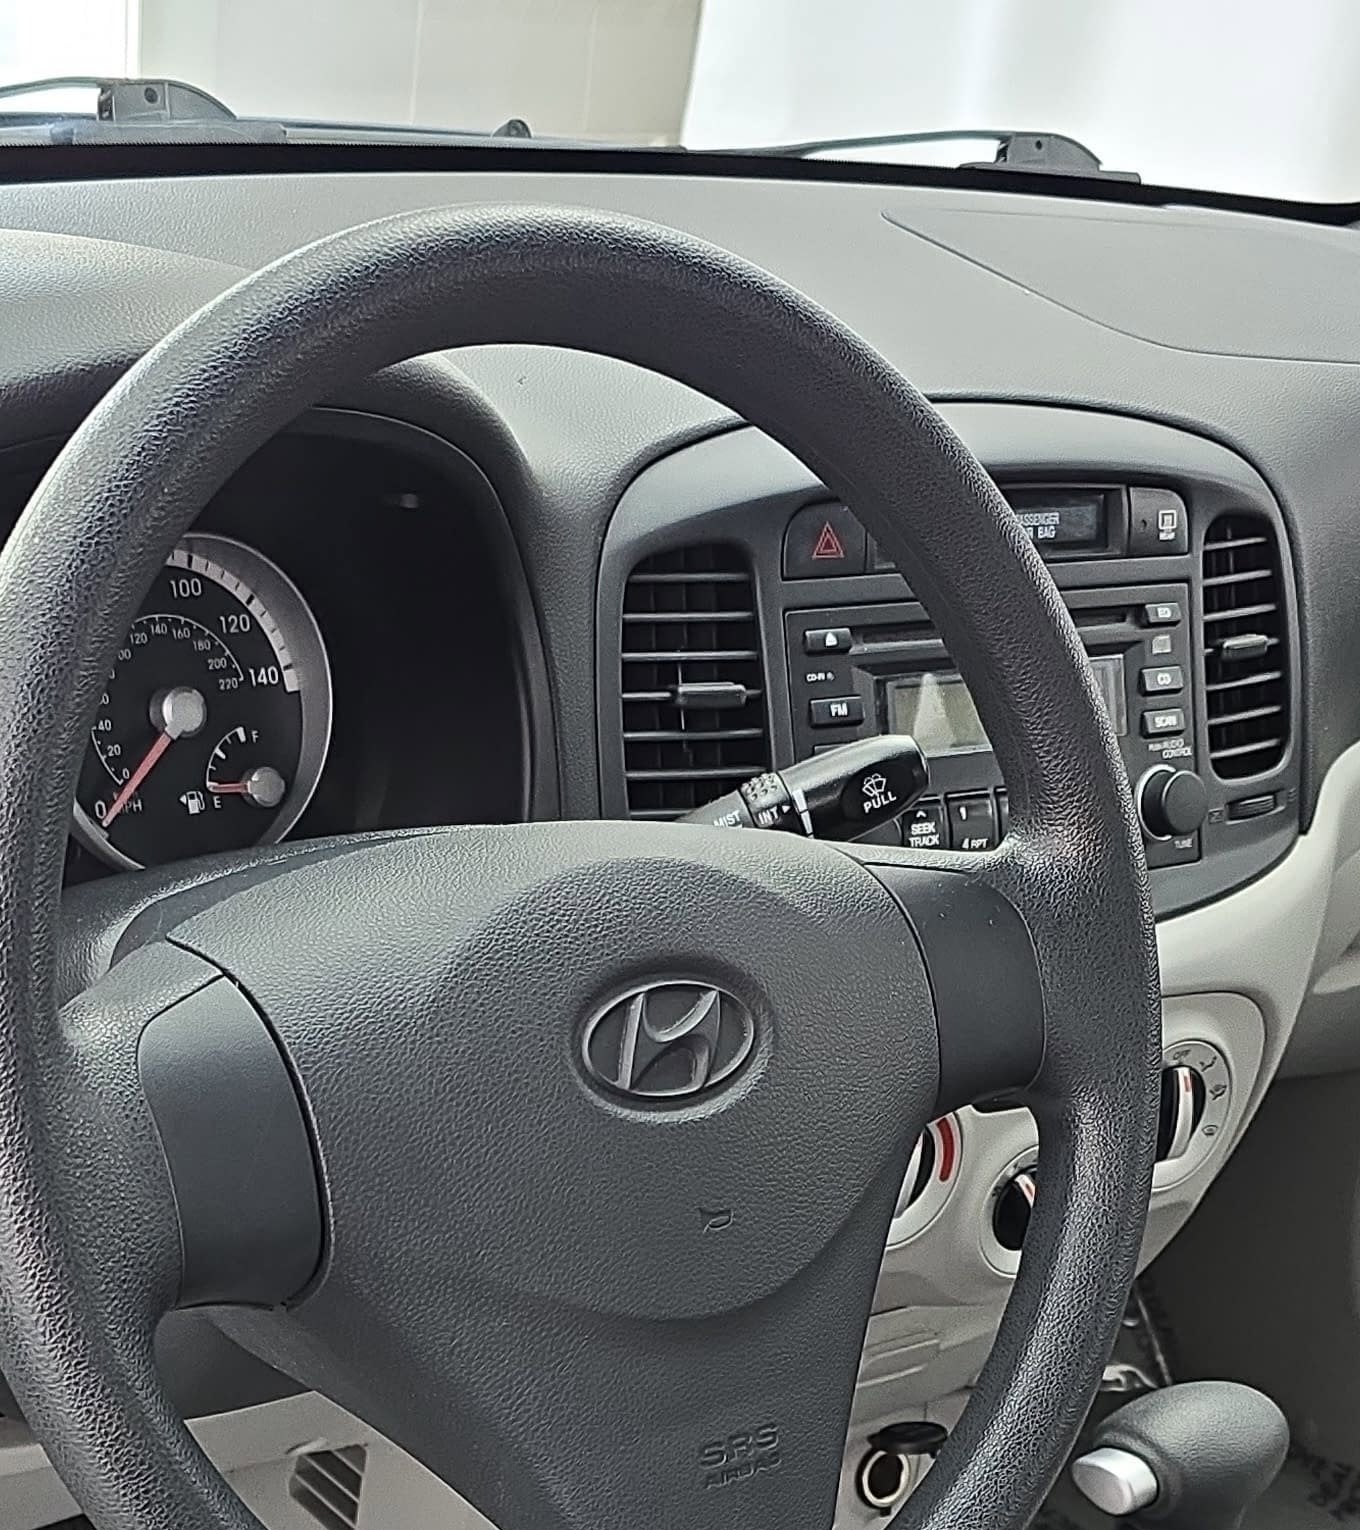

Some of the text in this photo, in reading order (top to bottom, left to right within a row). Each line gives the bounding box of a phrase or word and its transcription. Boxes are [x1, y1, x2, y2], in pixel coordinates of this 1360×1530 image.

[170, 578, 202, 598] 100
[150, 623, 168, 635] 140
[219, 614, 251, 634] 120
[130, 632, 148, 645] 120
[172, 628, 190, 640] 160
[207, 658, 227, 671] 200
[249, 666, 279, 687] 140
[218, 678, 238, 690] 220
[830, 703, 848, 717] FM
[98, 719, 112, 732] 40
[252, 731, 260, 743] F
[107, 744, 121, 756] 20
[122, 769, 130, 780] 0
[214, 796, 221, 809] E
[863, 791, 897, 814] PULL
[95, 800, 107, 820] 0
[713, 810, 741, 828] MIST
[758, 808, 778, 826] INT
[911, 822, 935, 835] SEEK
[909, 834, 940, 848] TRACK
[962, 838, 969, 849] 4
[702, 1423, 780, 1469] SRS
